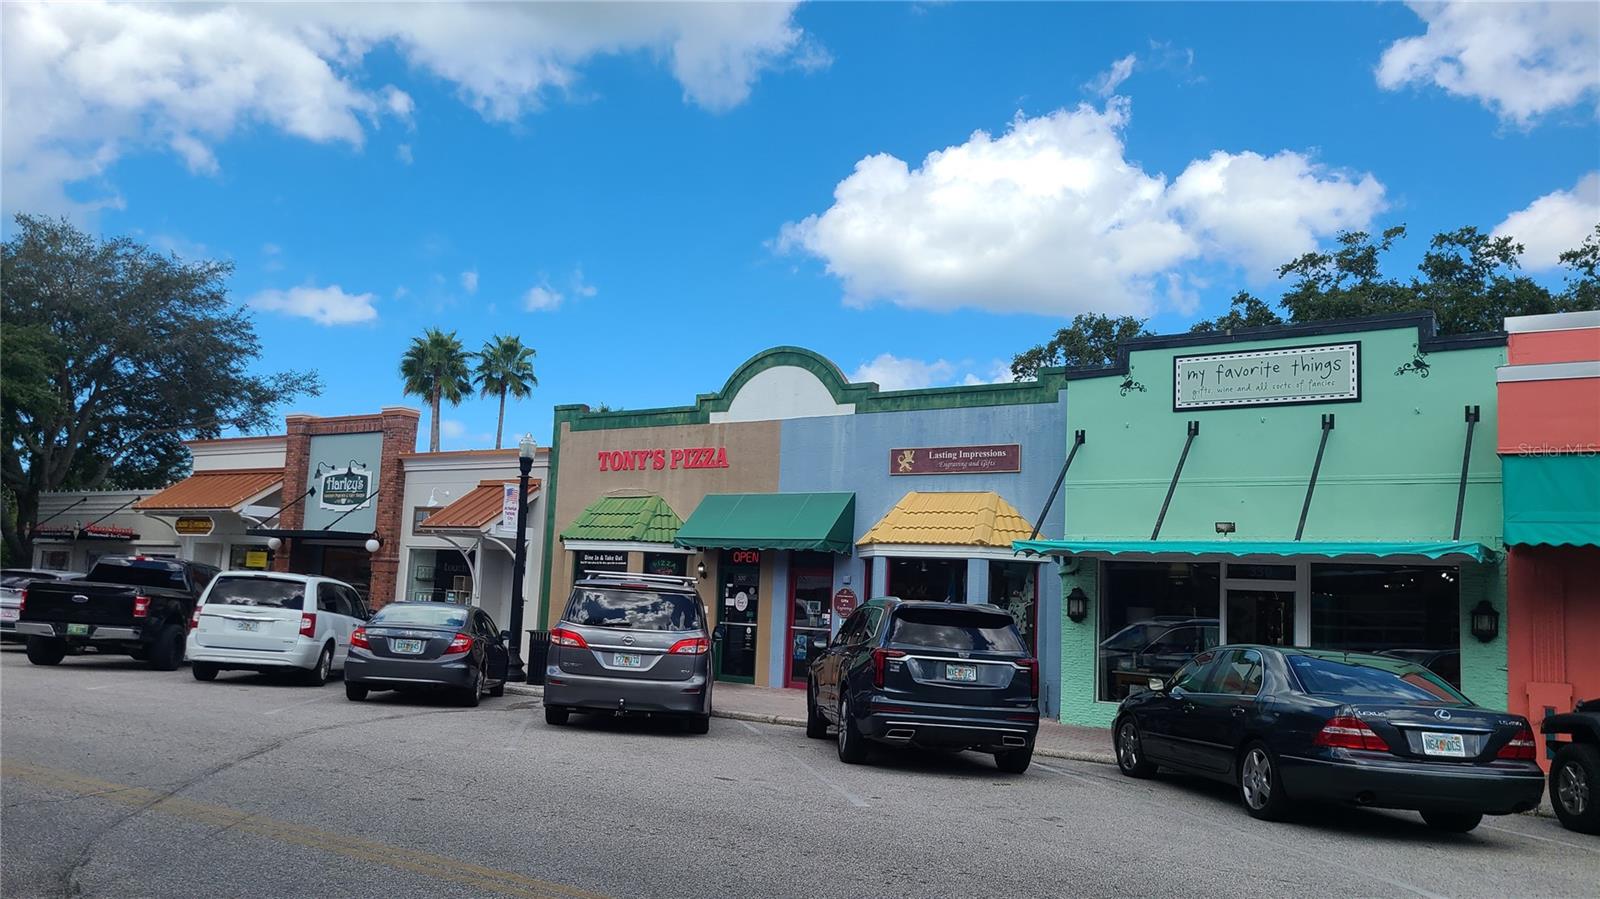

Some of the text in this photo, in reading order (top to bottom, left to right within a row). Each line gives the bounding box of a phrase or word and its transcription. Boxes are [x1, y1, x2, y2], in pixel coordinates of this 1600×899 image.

[1187, 355, 1342, 386] my favorite things
[1236, 384, 1251, 392] and
[1255, 382, 1268, 391] all
[1272, 382, 1292, 390] sorts
[1296, 379, 1305, 388] of
[1308, 378, 1336, 391] fancies
[598, 447, 729, 471] TONY'S PIZZA
[929, 449, 1007, 460] Lasting Impressions
[938, 461, 967, 470] Engraving
[980, 459, 996, 469] Gifts
[326, 476, 364, 493] Harley's
[733, 551, 759, 563] OPEN
